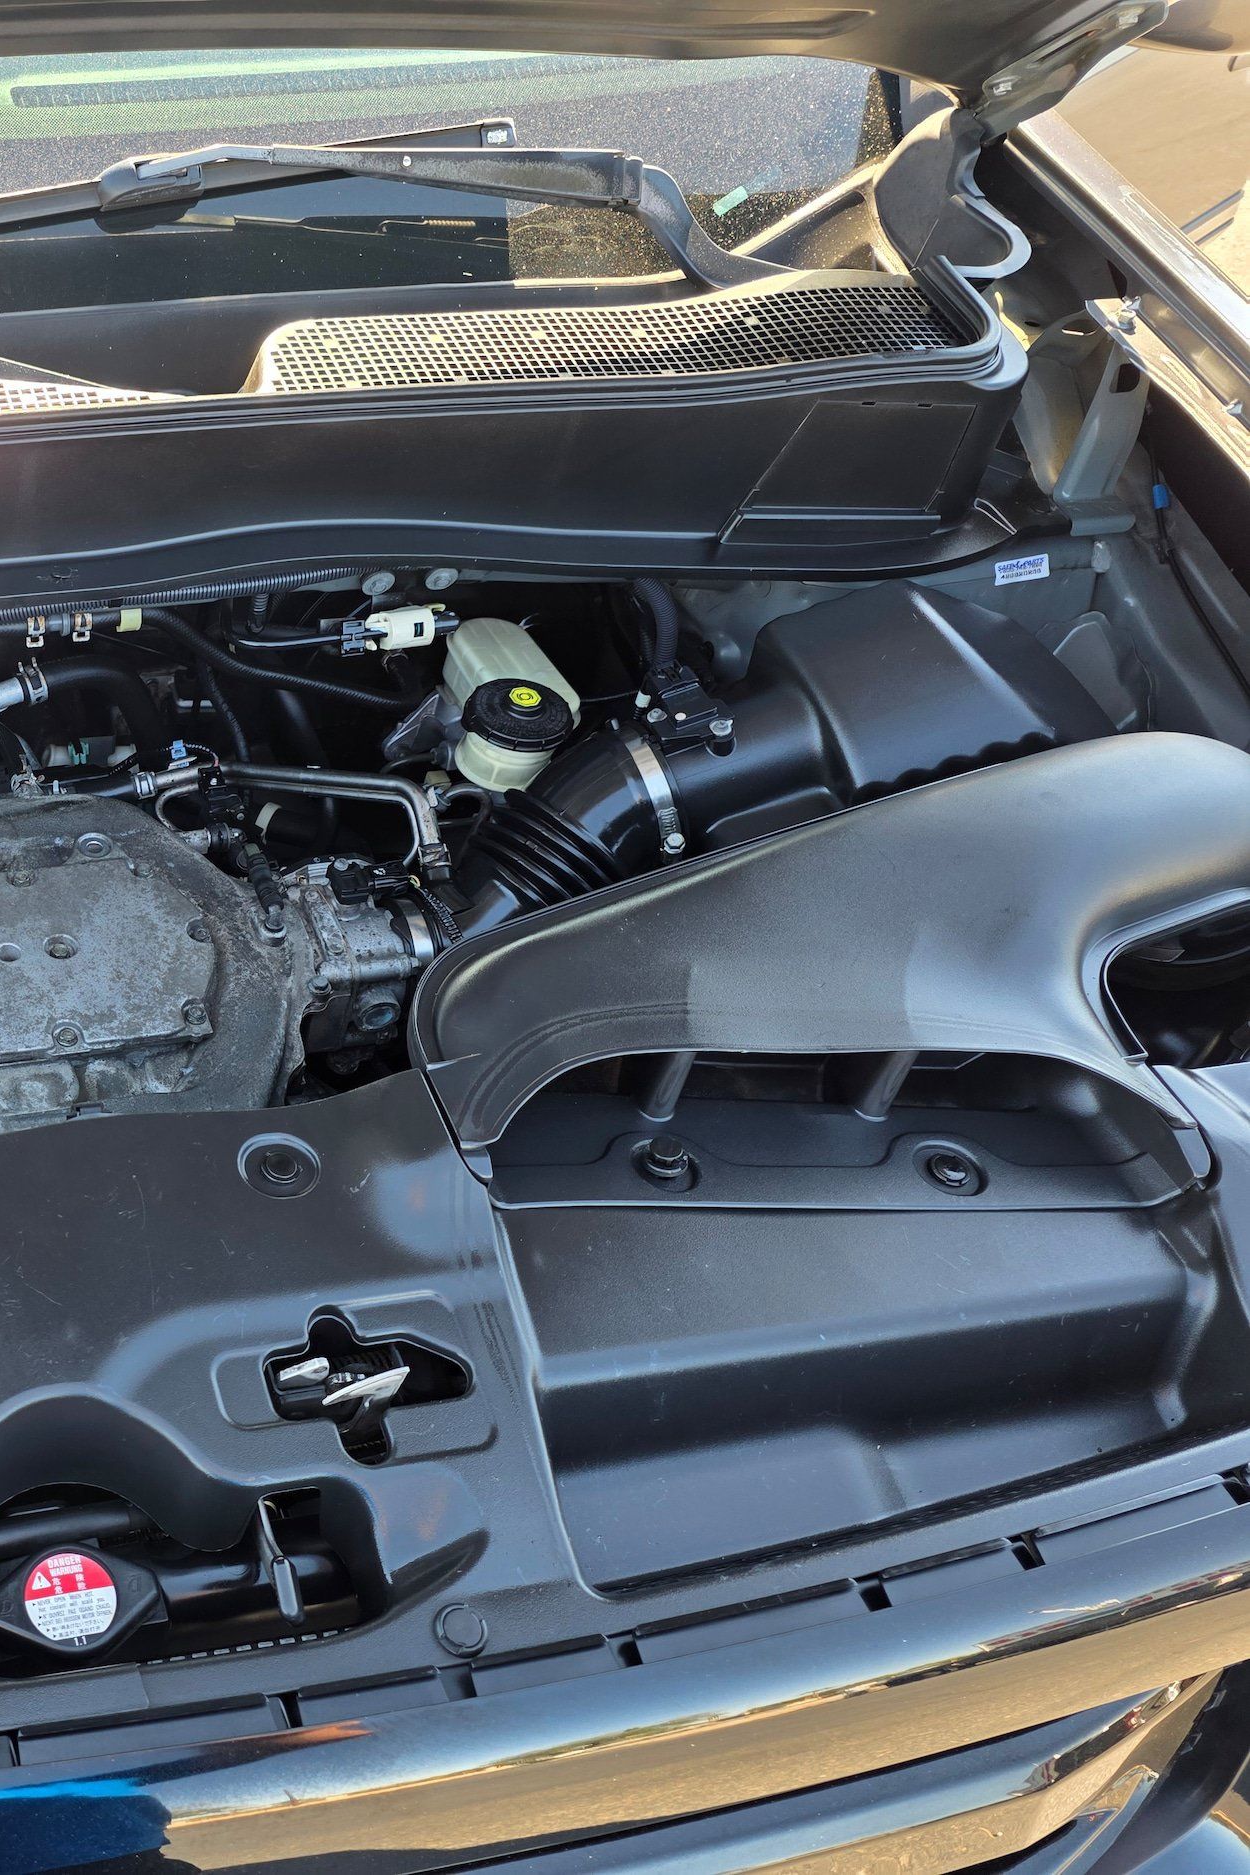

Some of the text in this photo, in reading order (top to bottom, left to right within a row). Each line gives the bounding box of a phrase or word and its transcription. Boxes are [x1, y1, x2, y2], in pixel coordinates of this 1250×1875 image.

[48, 1556, 81, 1568] DANGER
[50, 1564, 83, 1577] WARNUNG
[74, 1636, 87, 1647] 1.1
